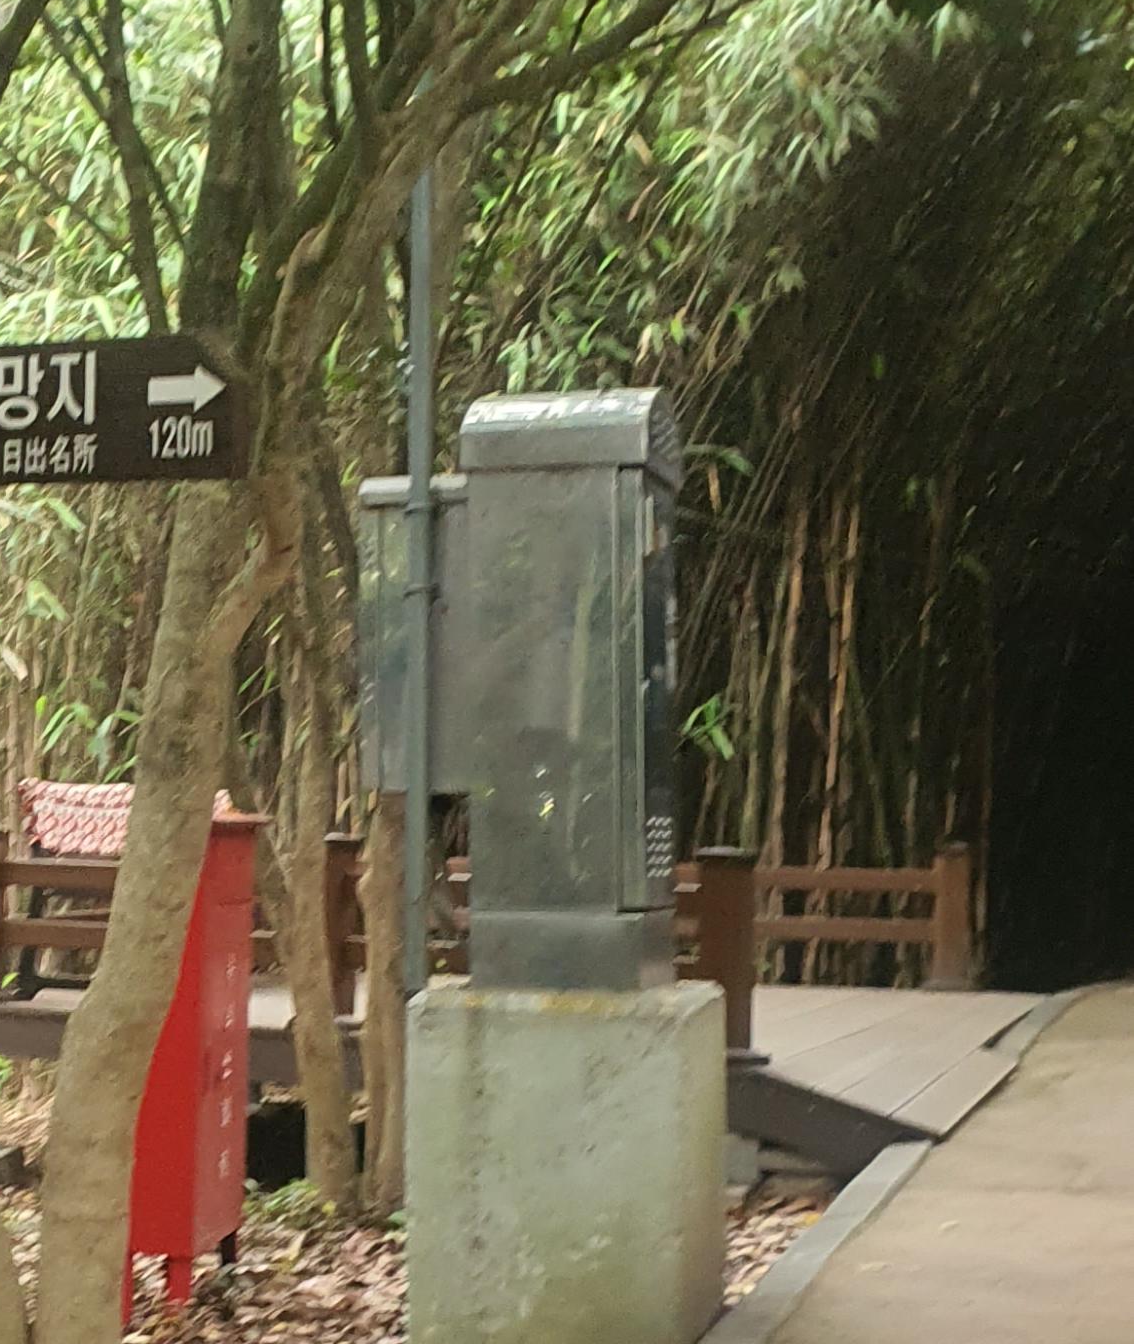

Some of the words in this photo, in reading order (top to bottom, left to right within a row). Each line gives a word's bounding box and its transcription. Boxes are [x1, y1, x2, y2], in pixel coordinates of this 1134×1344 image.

[2, 433, 99, 476] 日出名所
[148, 415, 215, 460] 120m
